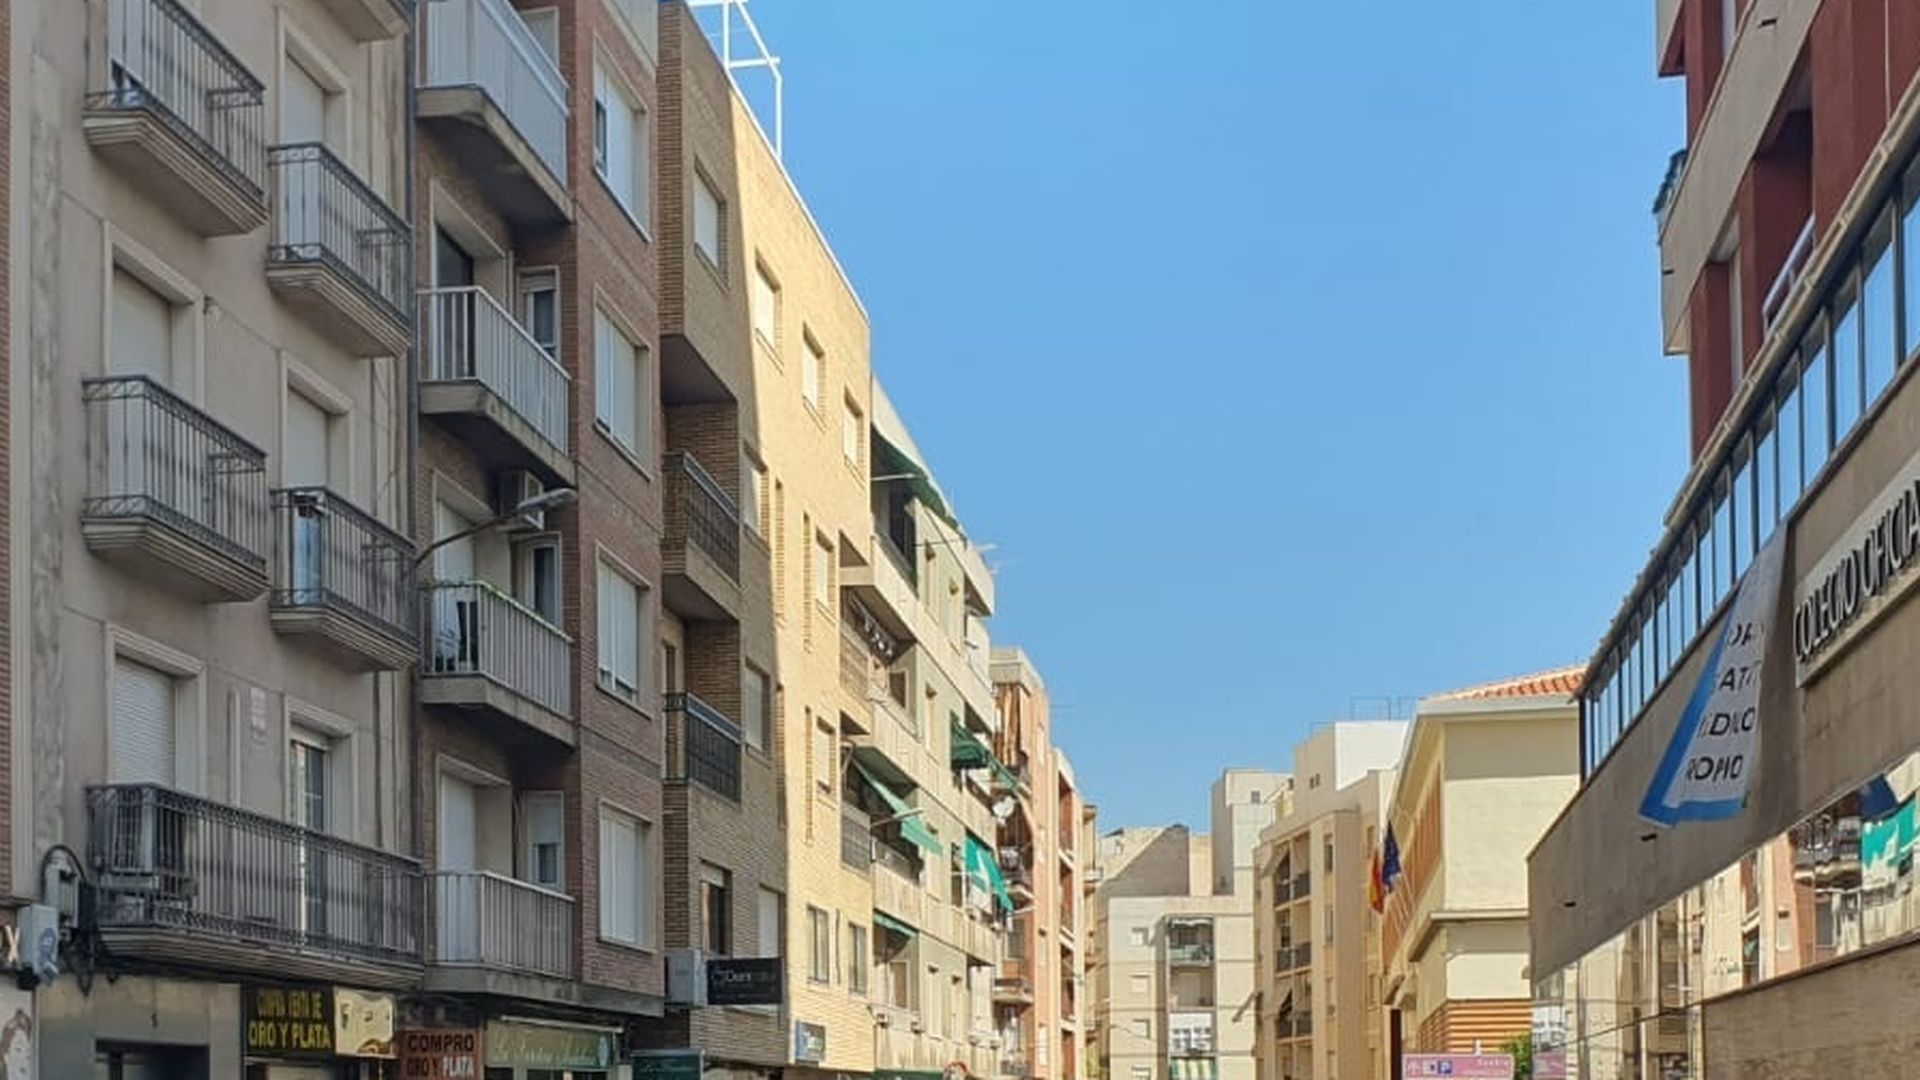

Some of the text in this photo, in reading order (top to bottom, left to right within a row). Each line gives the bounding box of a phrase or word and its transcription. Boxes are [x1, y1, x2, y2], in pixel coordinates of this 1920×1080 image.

[248, 1020, 331, 1049] ORO Y PLATA
[407, 1033, 475, 1053] COMPRO
